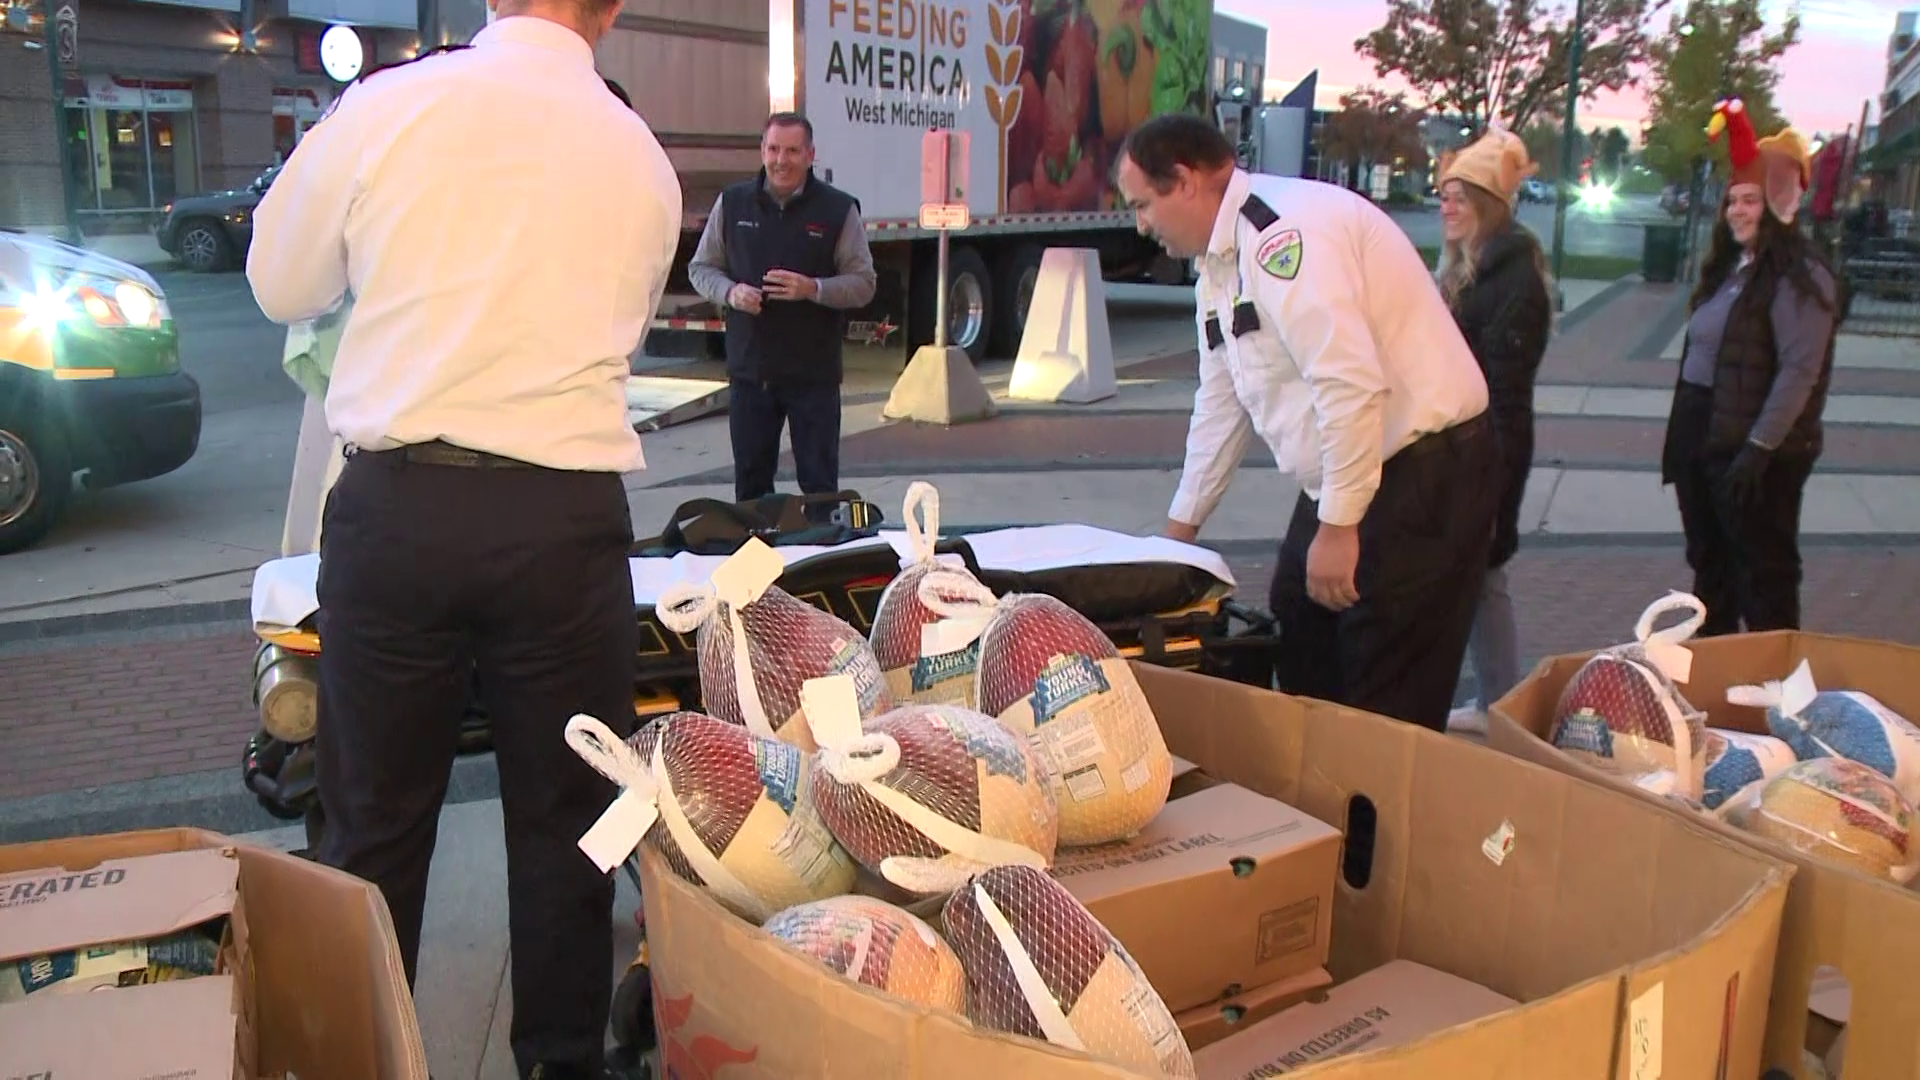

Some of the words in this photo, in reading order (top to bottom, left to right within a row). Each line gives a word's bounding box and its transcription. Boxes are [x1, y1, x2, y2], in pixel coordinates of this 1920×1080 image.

[828, 0, 967, 52] FEEDING
[825, 40, 967, 99] AMERICA
[846, 97, 886, 124] West
[892, 103, 955, 131] Michigan
[1045, 662, 1089, 691] YOUNG
[1046, 669, 1094, 702] TURKEY
[1168, 832, 1226, 853] LABEL
